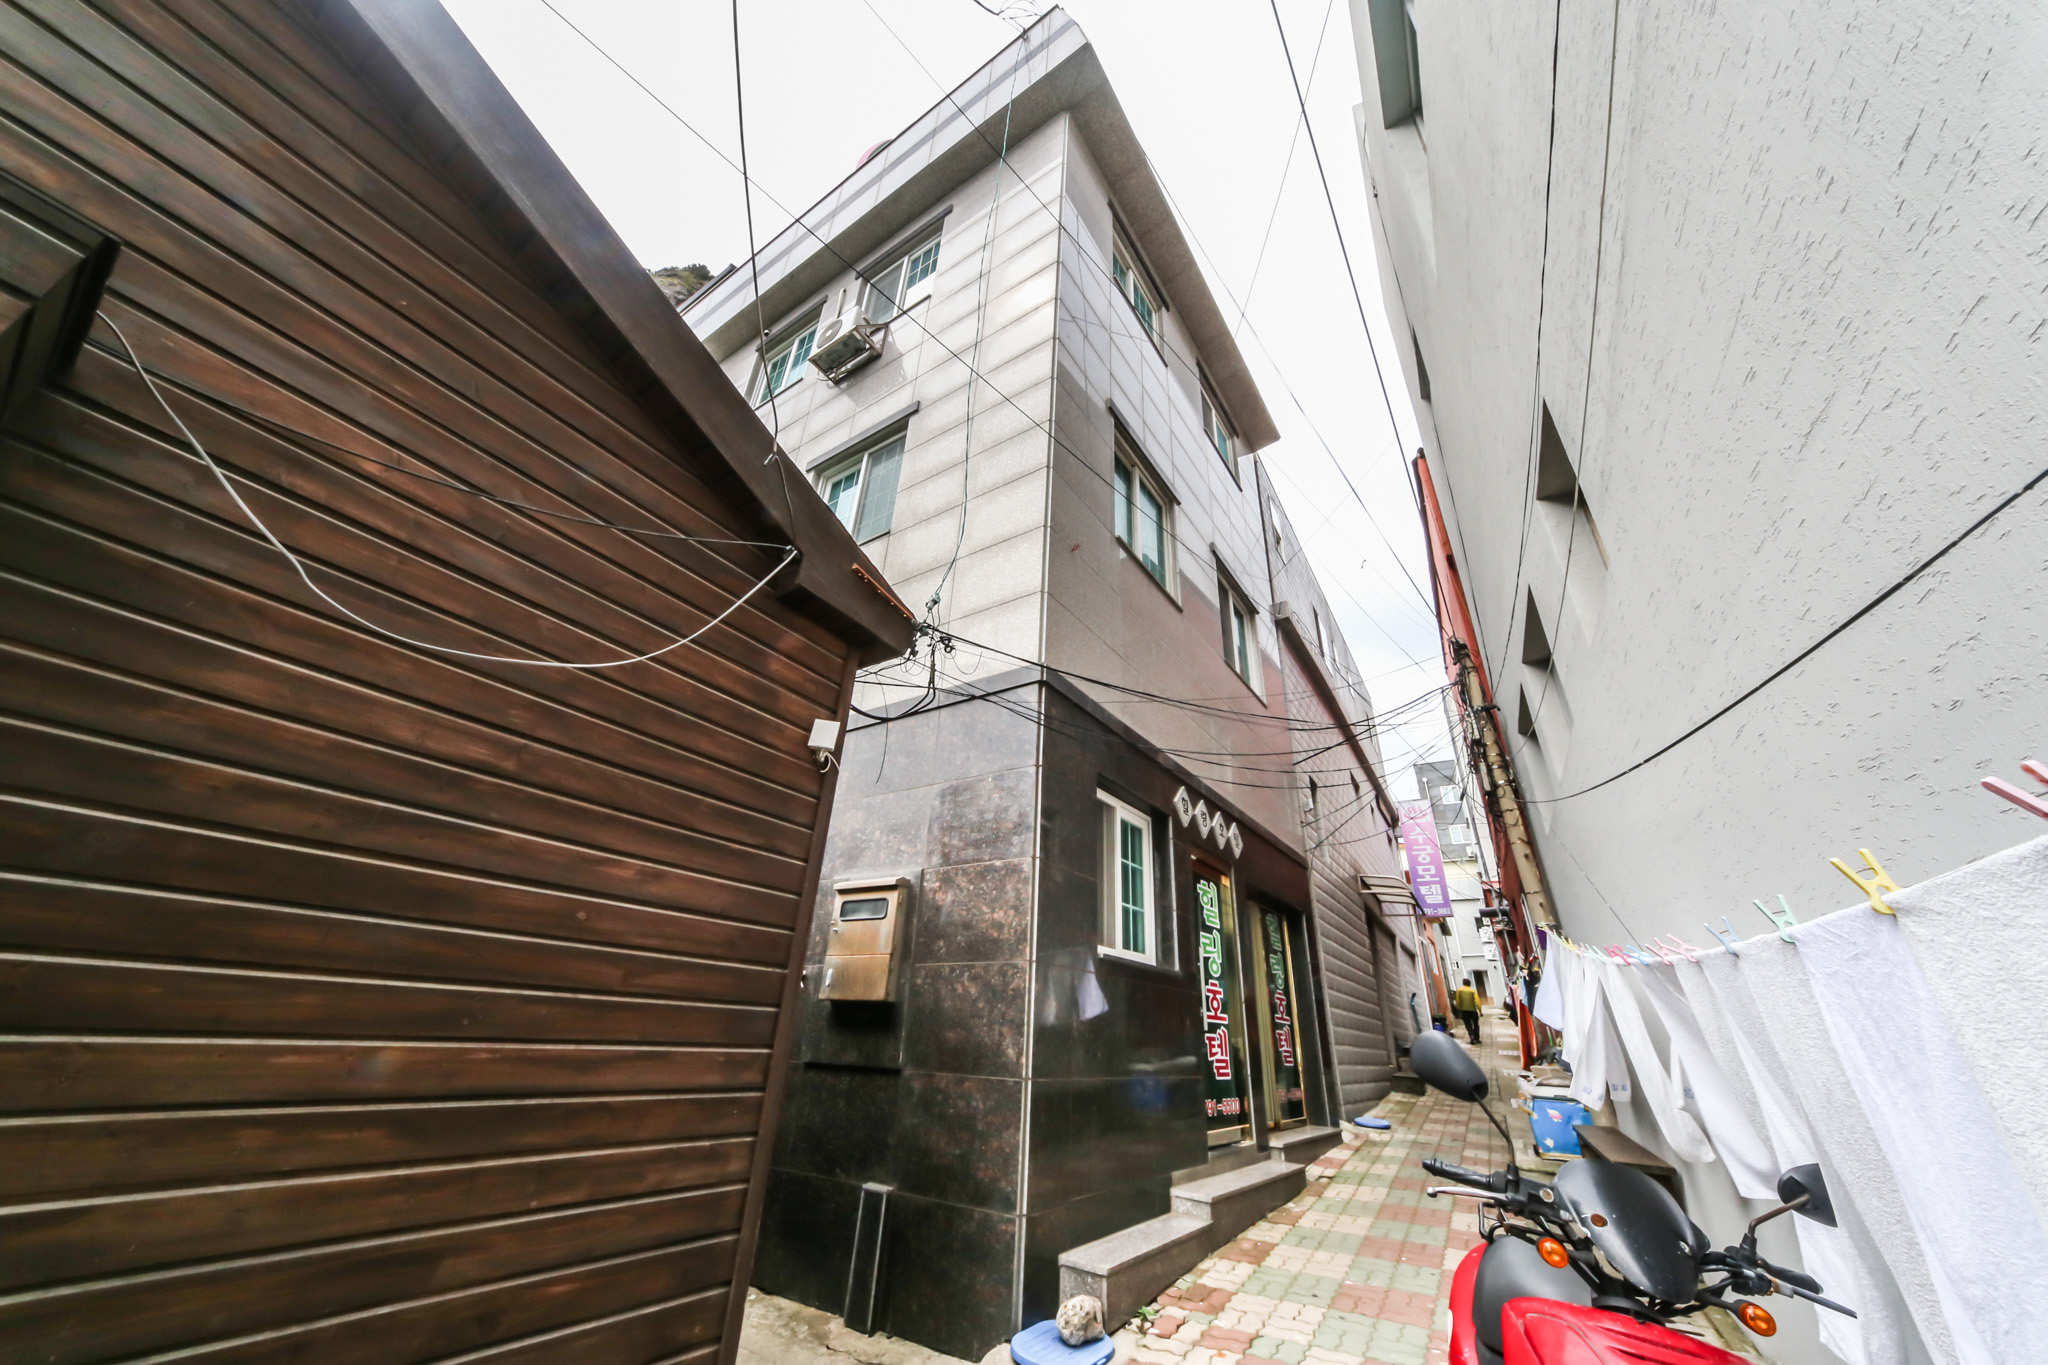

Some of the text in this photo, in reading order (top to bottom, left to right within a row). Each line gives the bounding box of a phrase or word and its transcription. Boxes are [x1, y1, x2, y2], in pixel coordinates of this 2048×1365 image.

[1408, 826, 1444, 904] 수궁모텔
[1196, 879, 1232, 1080] 힐링호텔
[1265, 912, 1295, 1067] 힐링호텔
